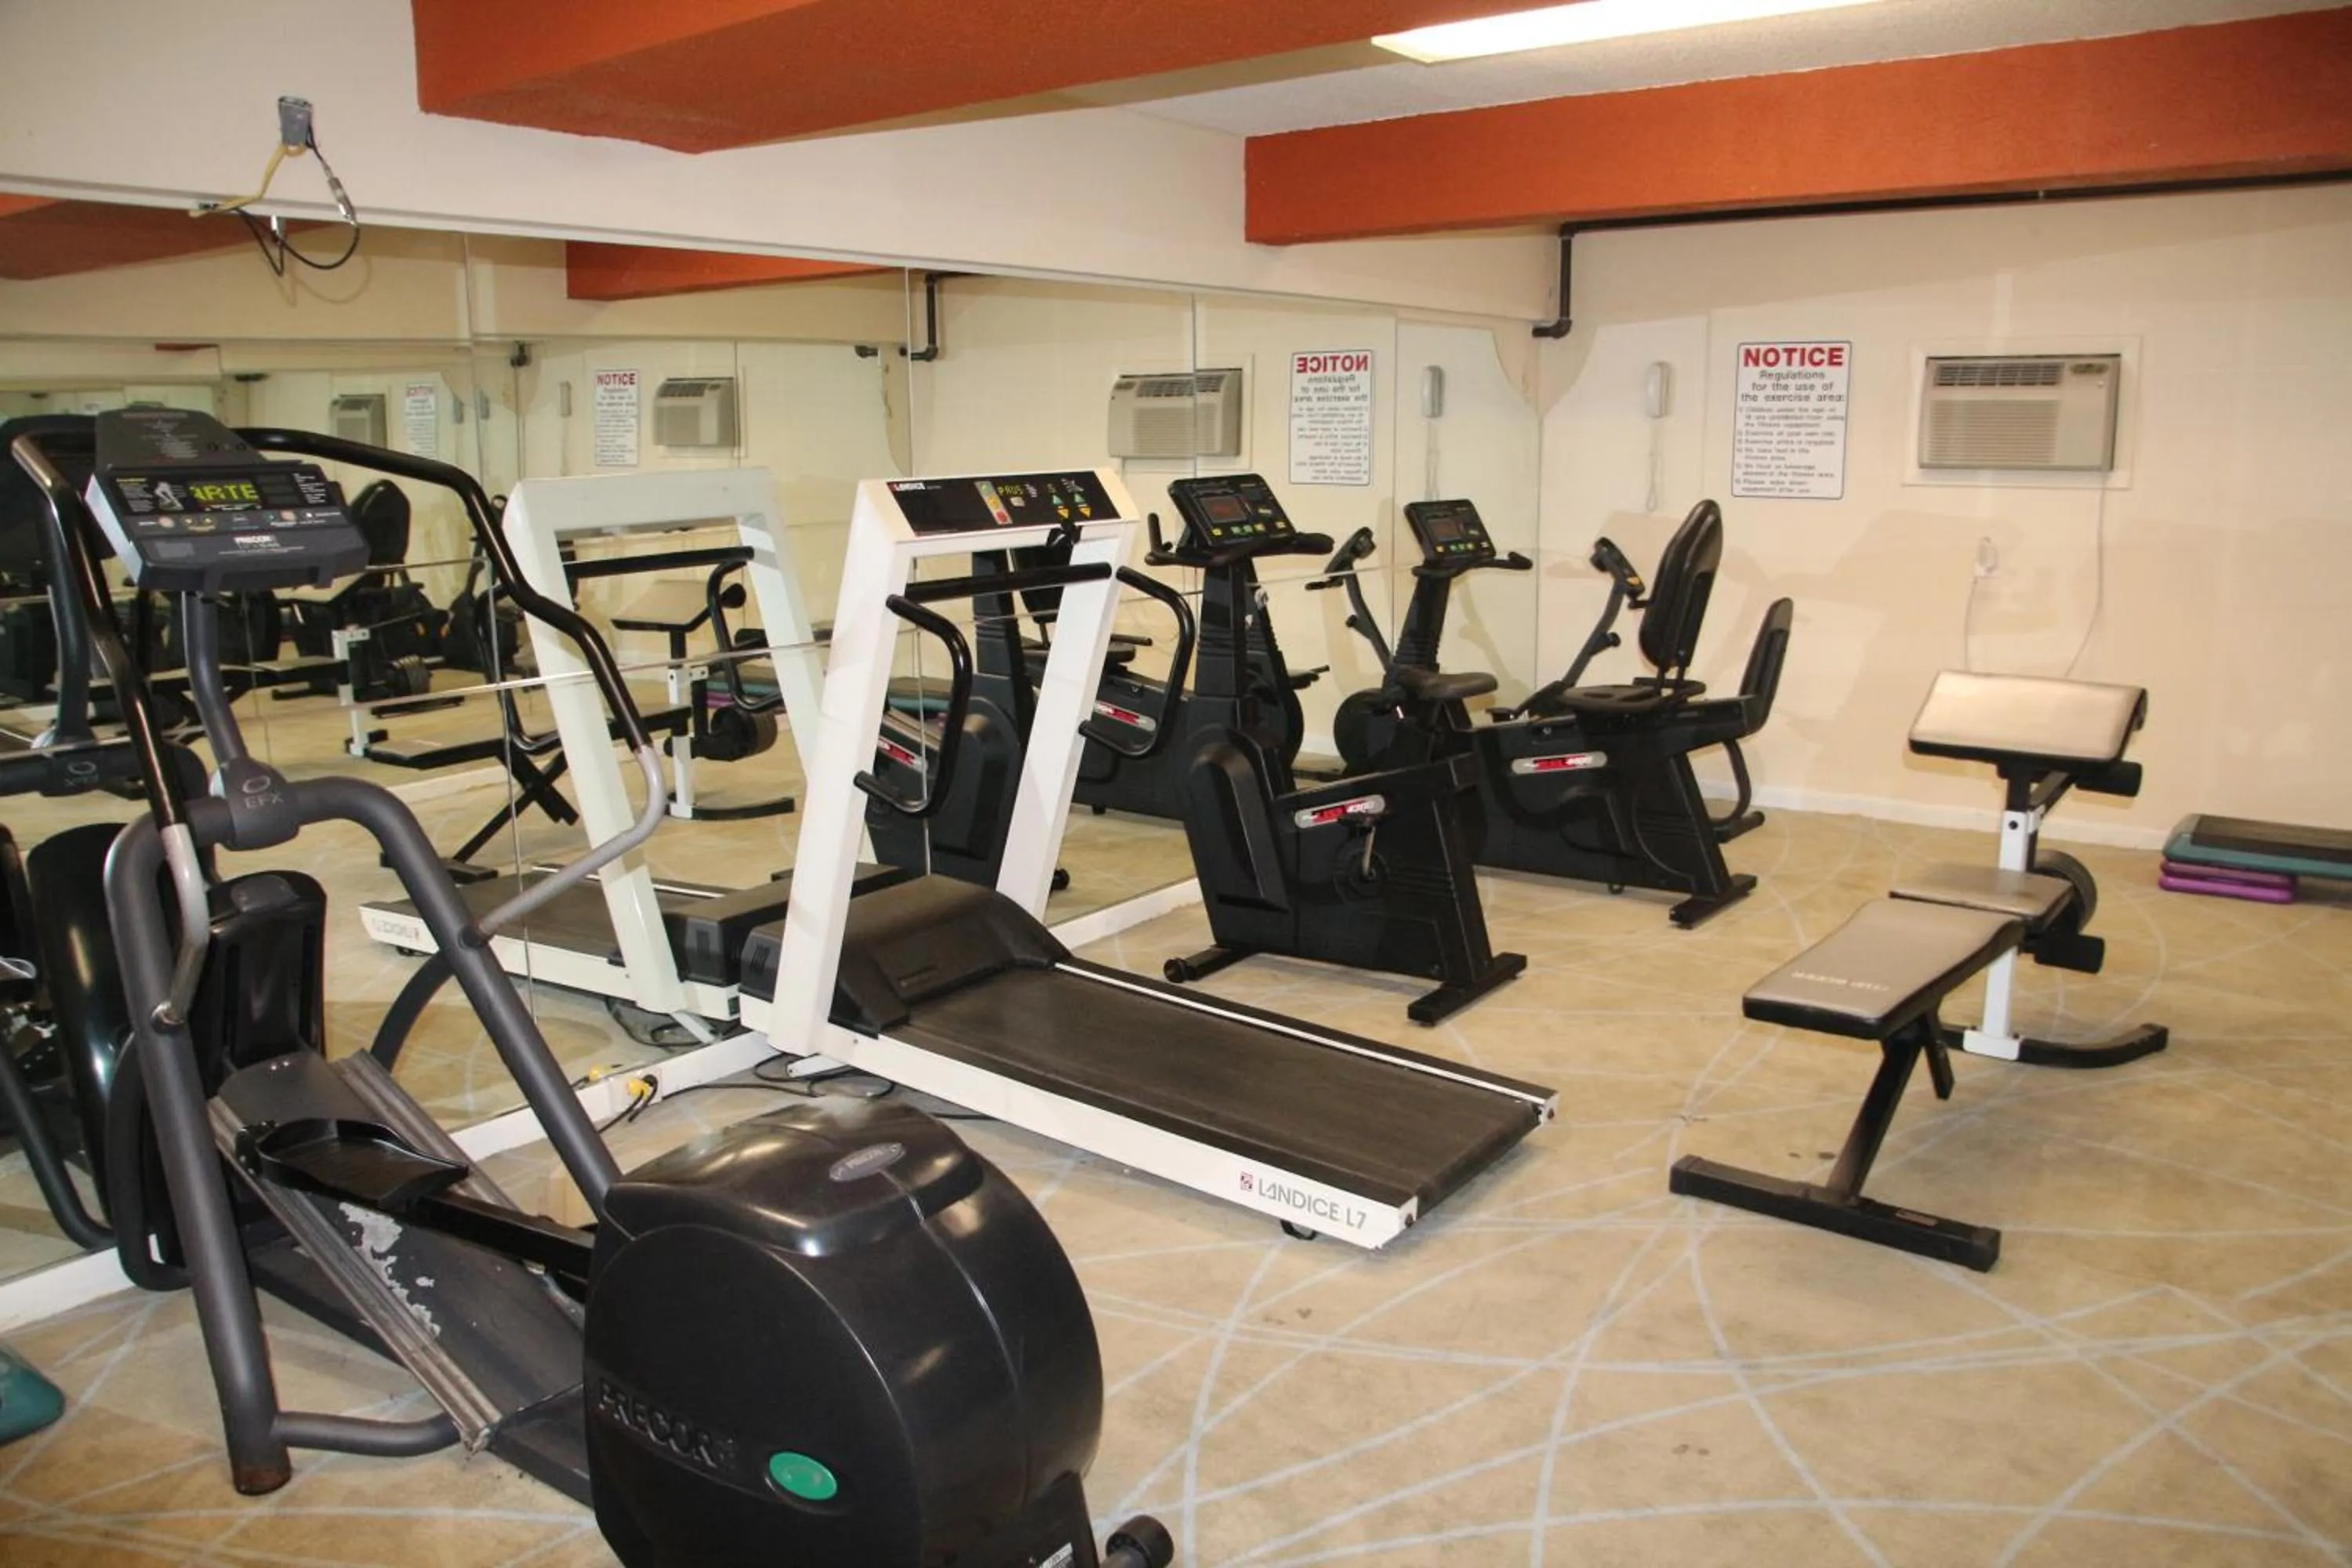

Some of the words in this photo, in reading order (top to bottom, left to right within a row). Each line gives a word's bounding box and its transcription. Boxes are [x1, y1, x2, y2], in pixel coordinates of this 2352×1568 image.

[1744, 347, 1844, 368] NOTICE
[597, 373, 636, 387] NOTICE
[1759, 369, 1825, 381] Regulations
[1821, 381, 1834, 391] of
[1258, 1178, 1341, 1222] LANDICE
[1346, 1207, 1367, 1230] L7
[597, 1379, 719, 1469] PRECOR
